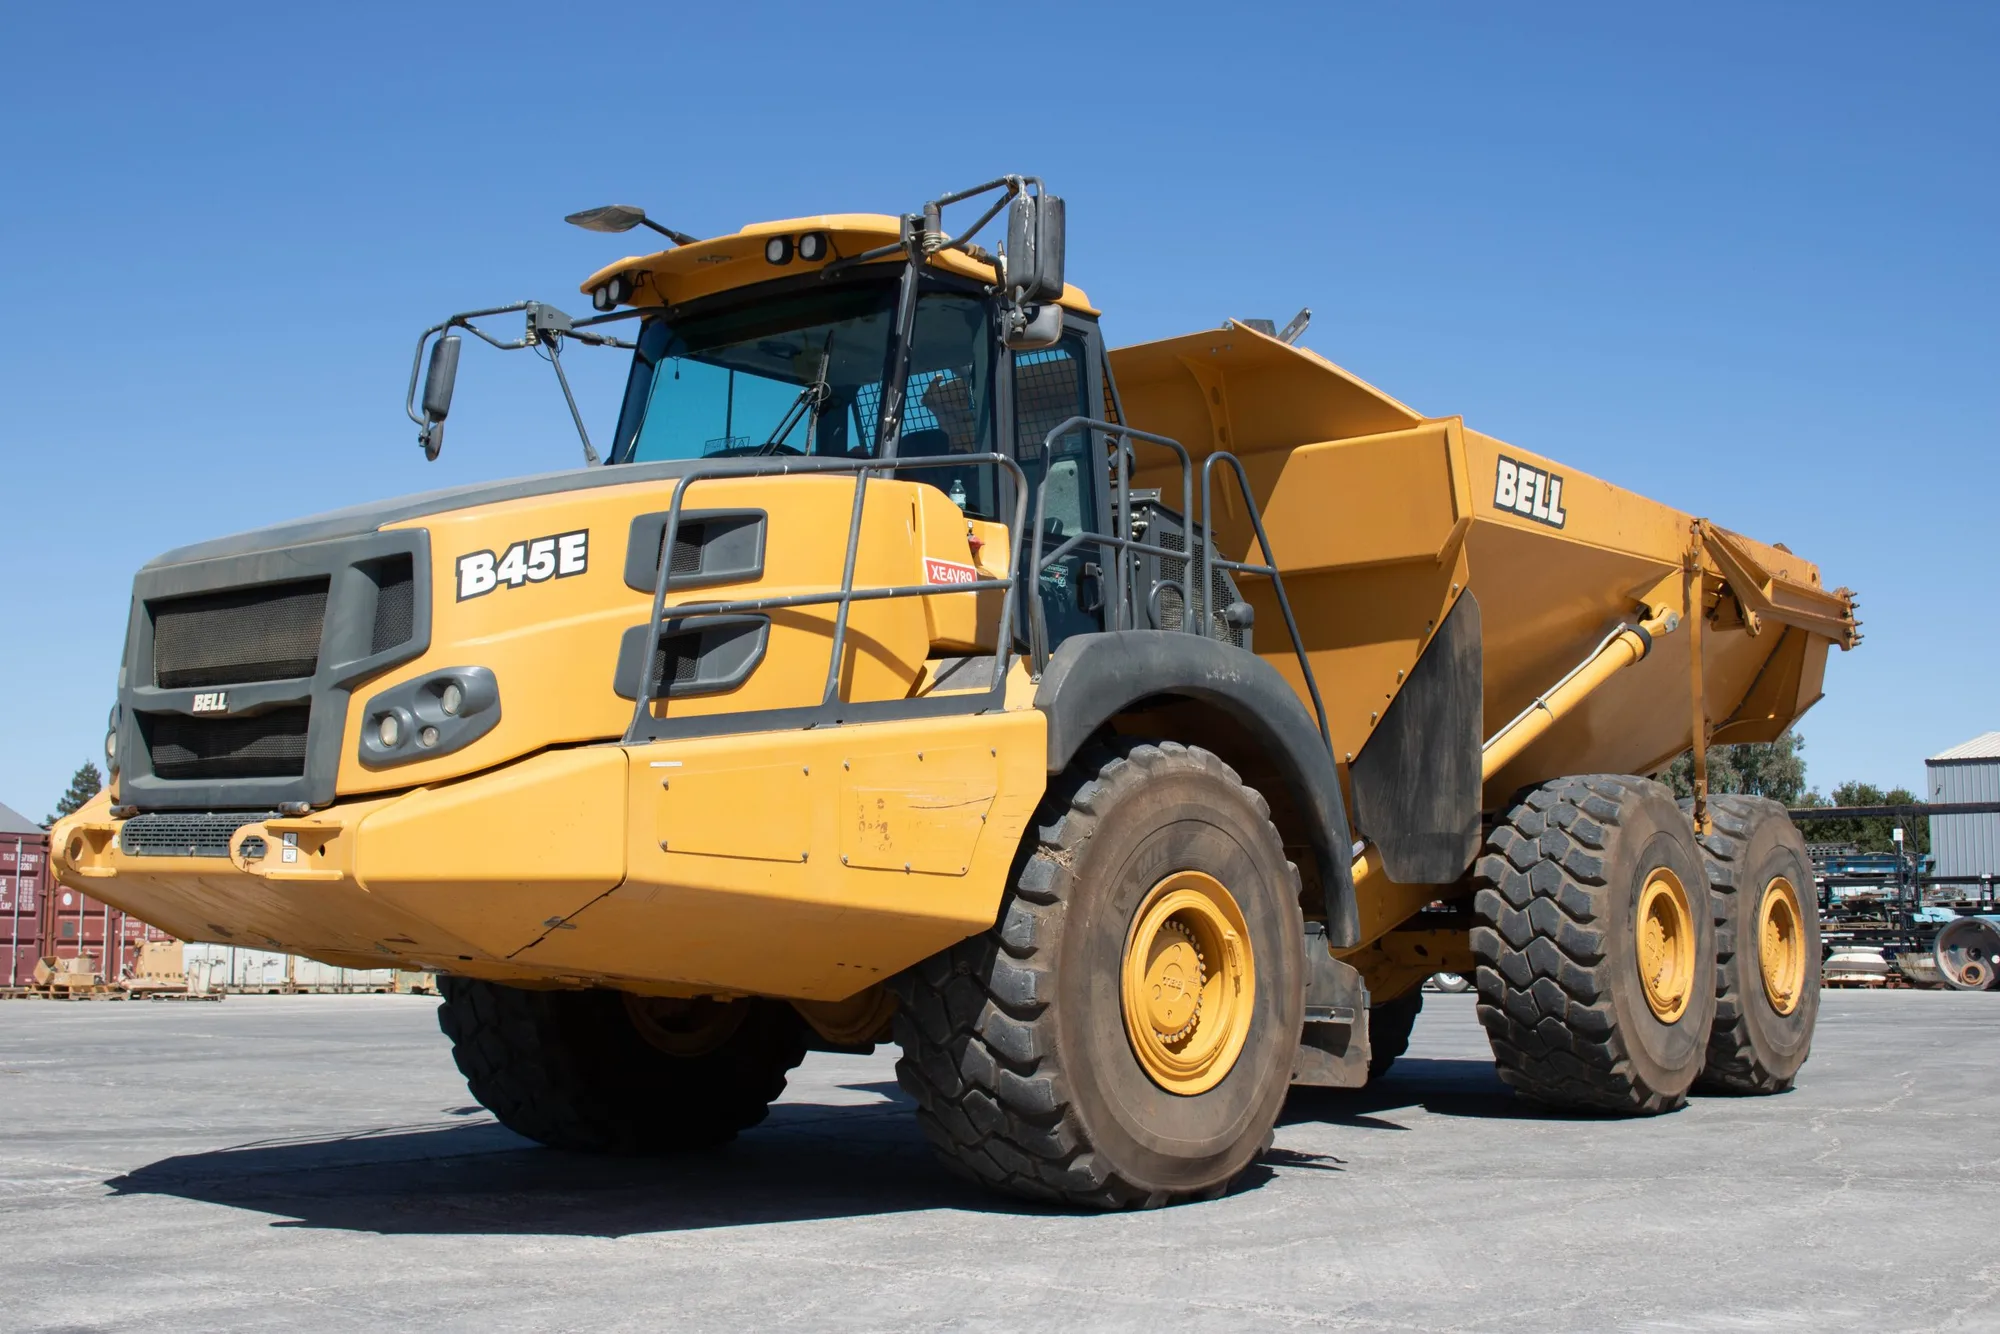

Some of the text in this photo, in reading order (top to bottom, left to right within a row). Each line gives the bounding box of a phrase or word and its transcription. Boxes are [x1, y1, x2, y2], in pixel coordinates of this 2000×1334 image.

[1493, 453, 1566, 530] BELL
[455, 528, 589, 603] B45E
[931, 564, 973, 583] XE4V89
[193, 692, 226, 711] BELL
